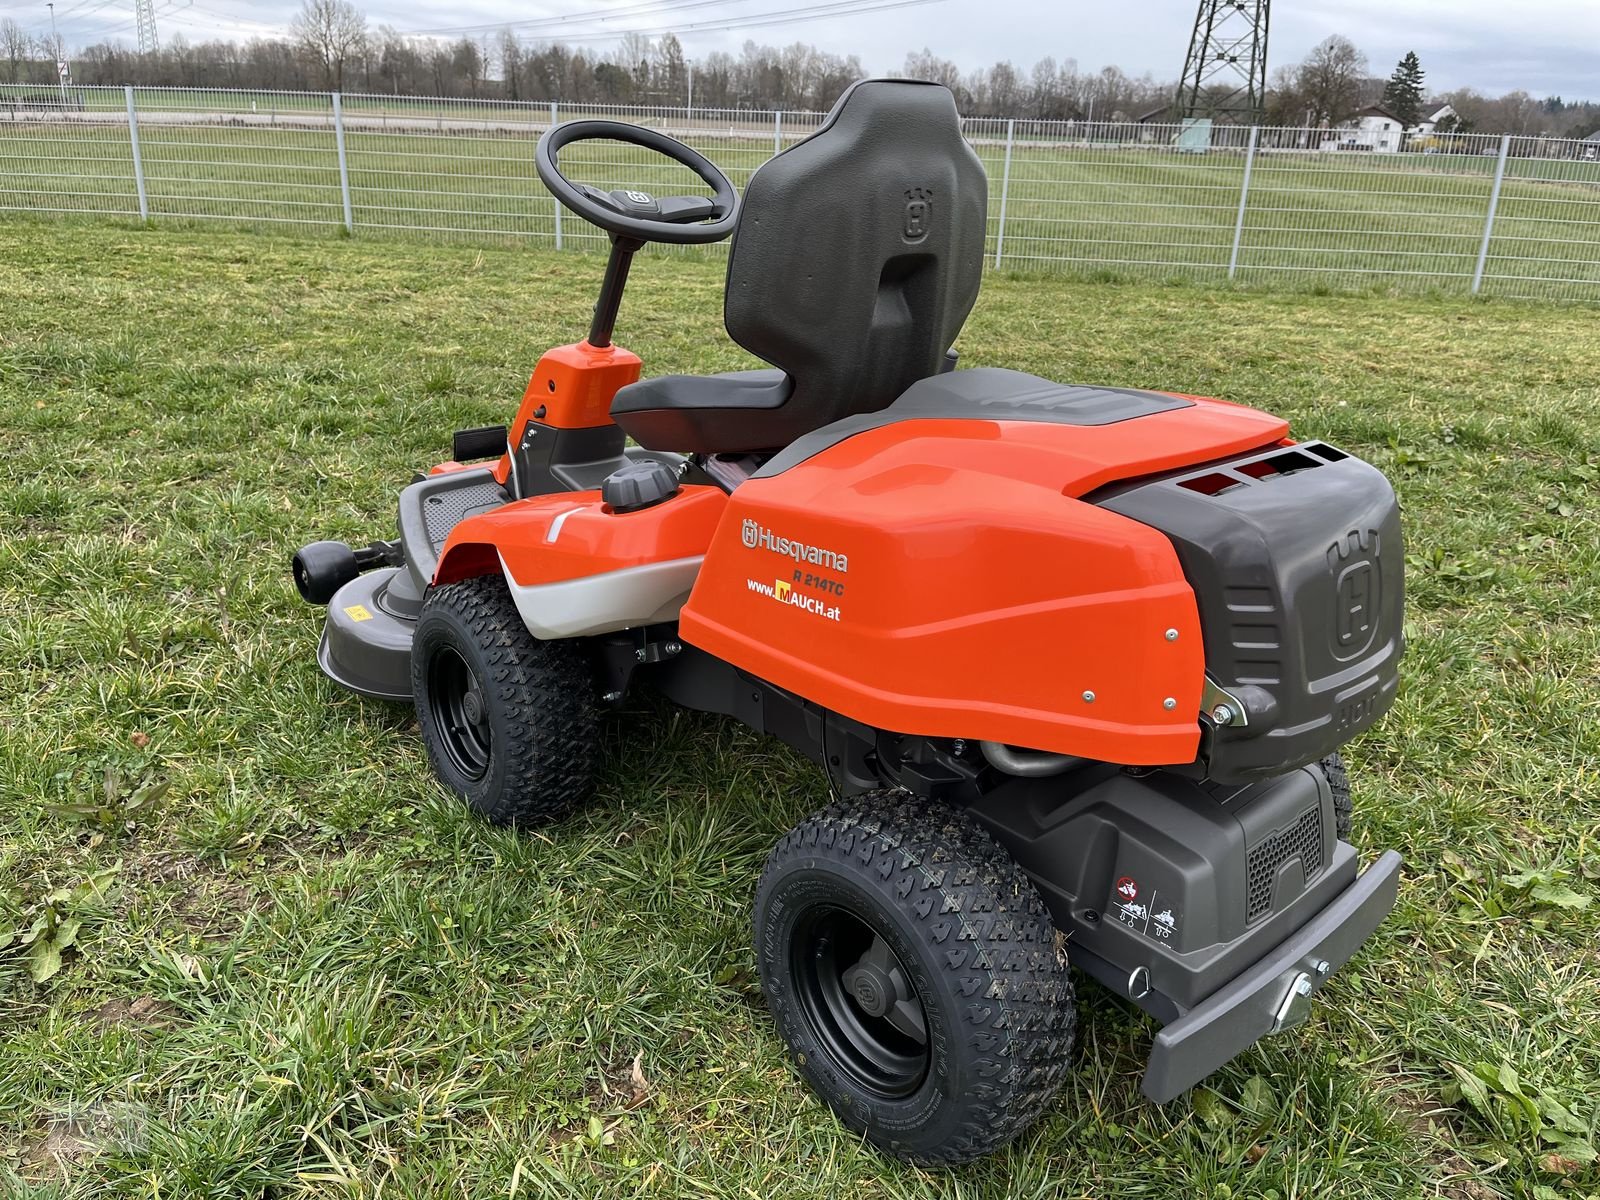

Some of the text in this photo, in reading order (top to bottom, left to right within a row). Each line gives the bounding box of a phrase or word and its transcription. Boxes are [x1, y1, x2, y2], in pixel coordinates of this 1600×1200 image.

[759, 526, 848, 573] Husqvarna
[747, 578, 841, 622] www.MAUCH.at
[793, 569, 844, 596] R 214TC
